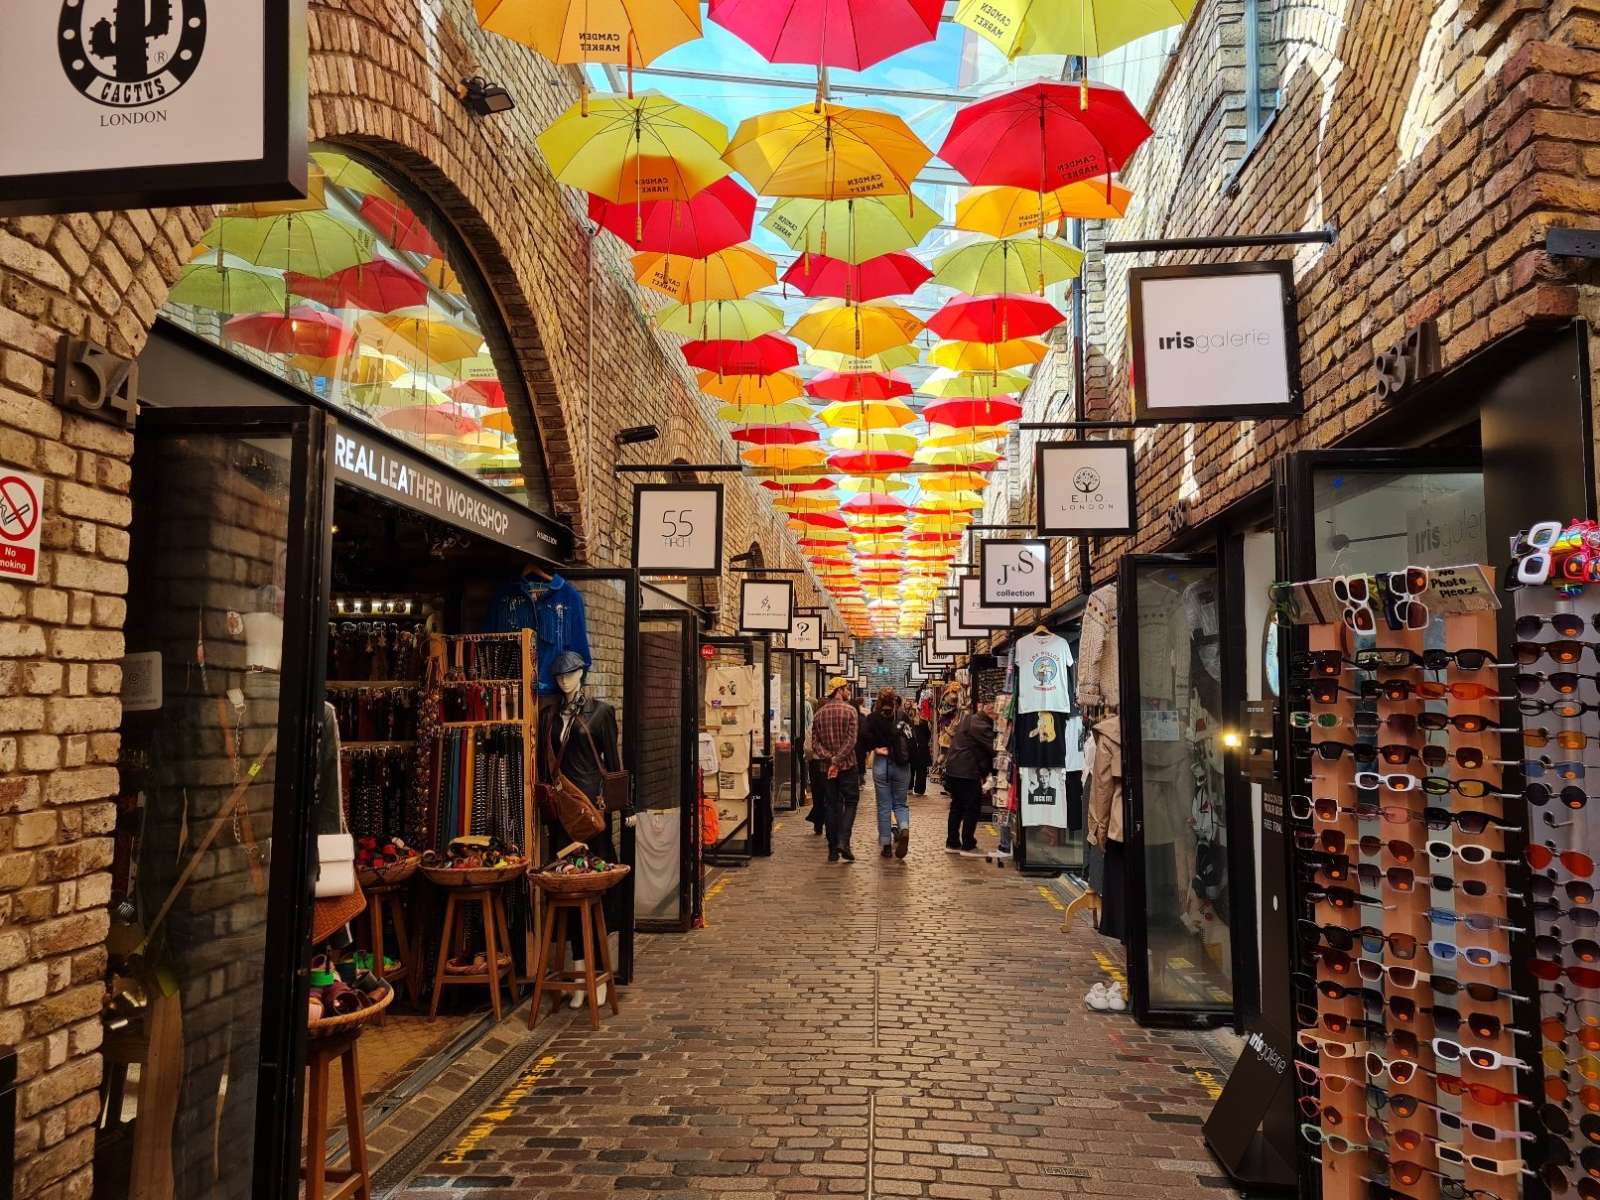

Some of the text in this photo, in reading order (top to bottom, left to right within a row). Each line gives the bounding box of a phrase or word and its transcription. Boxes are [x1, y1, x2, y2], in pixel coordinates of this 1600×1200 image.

[100, 77, 166, 104] CACTUS
[100, 109, 168, 128] LONDON
[60, 336, 138, 429] 54
[335, 432, 509, 536] REAL LEATHER WORKSHOP
[1061, 503, 1114, 511] LONDON
[660, 509, 694, 538] 55
[4, 546, 17, 558] No
[0, 557, 27, 572] moking
[996, 589, 1036, 598] collection
